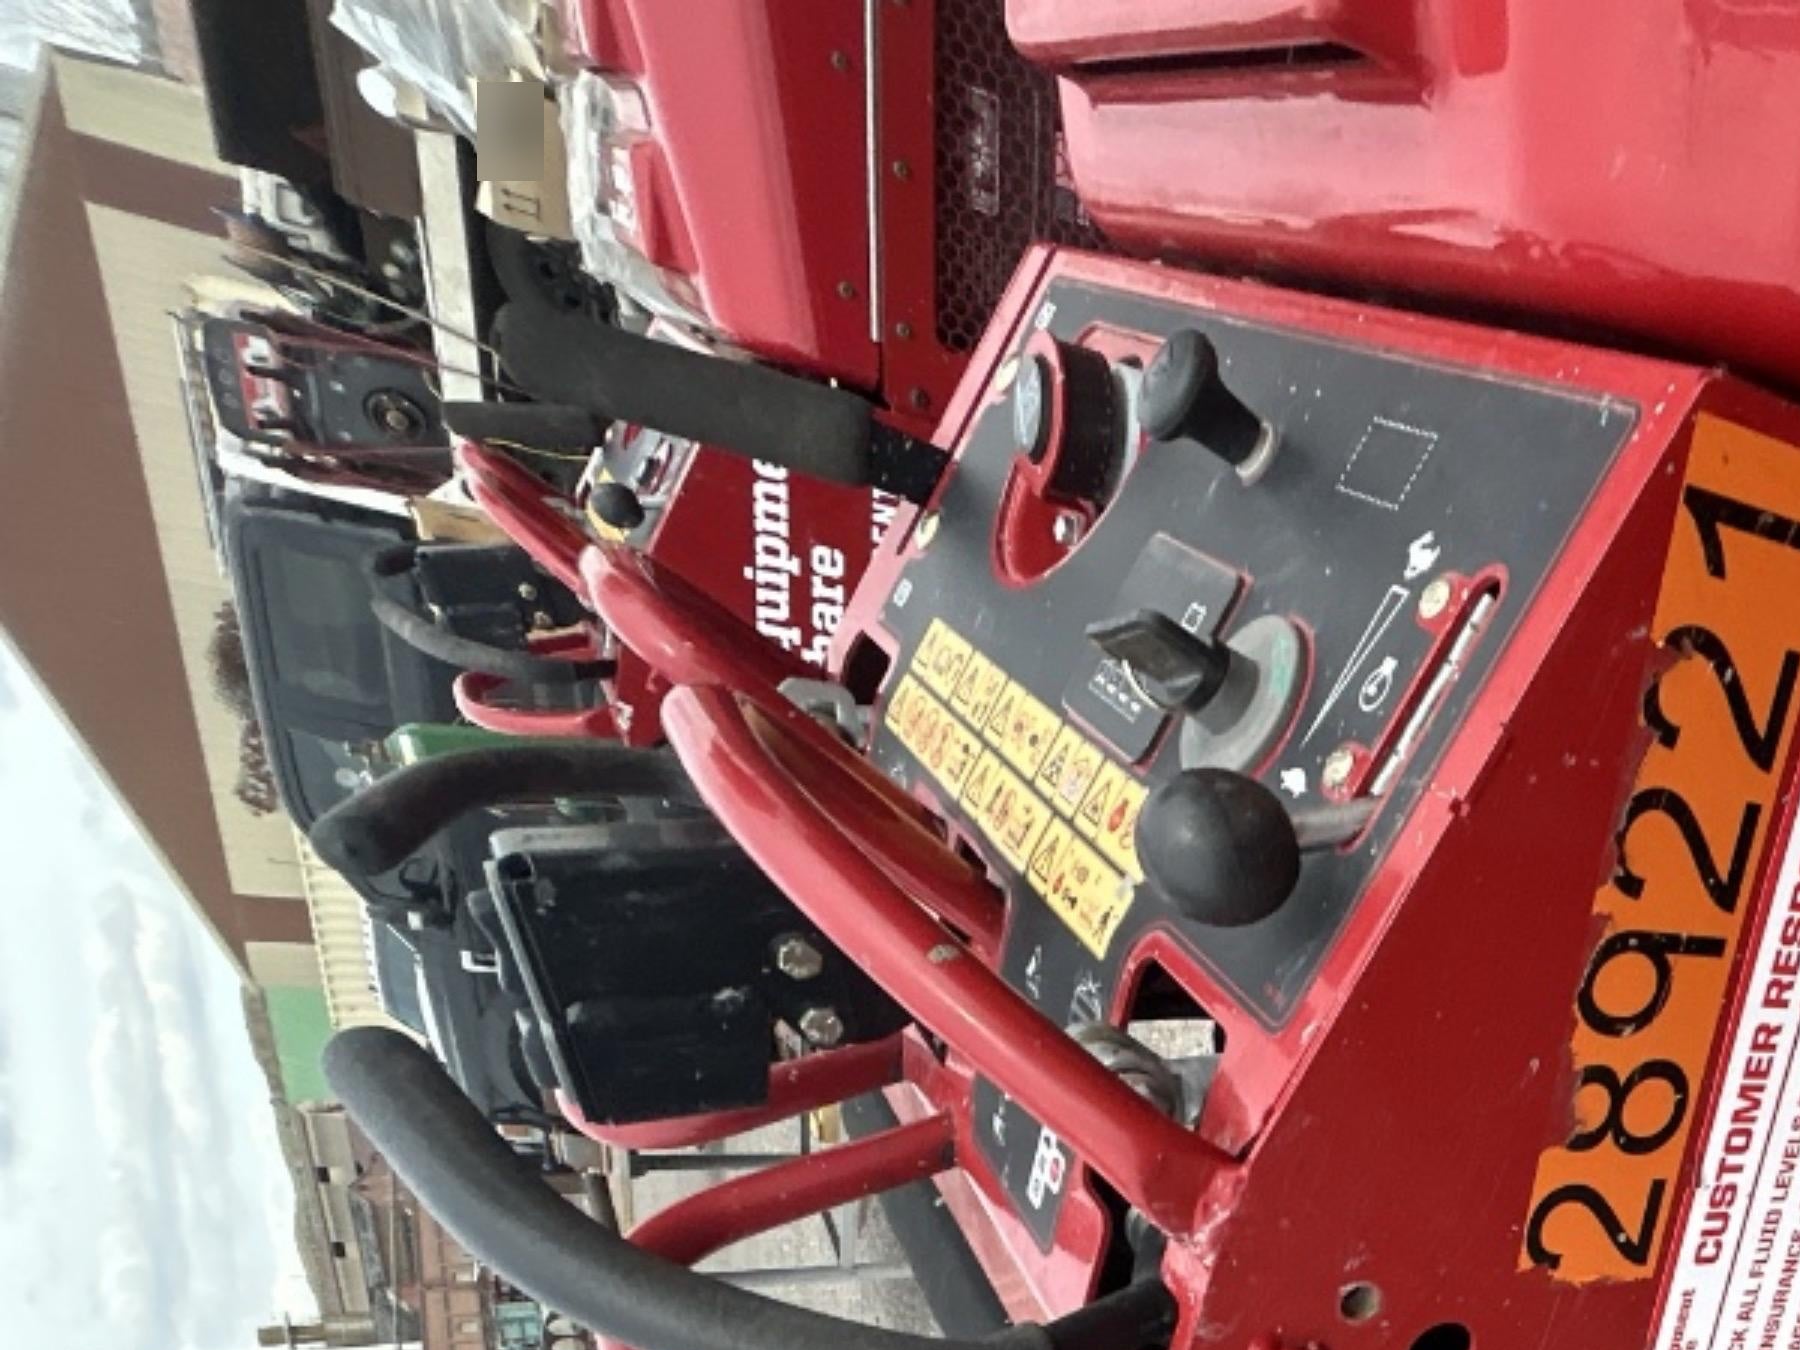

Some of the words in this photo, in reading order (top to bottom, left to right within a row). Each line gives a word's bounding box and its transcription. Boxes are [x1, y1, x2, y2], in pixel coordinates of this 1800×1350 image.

[1694, 1023, 1783, 1266] CUSTOMER
[1736, 1283, 1761, 1322] ALL
[1749, 1209, 1782, 1278] FLUID
